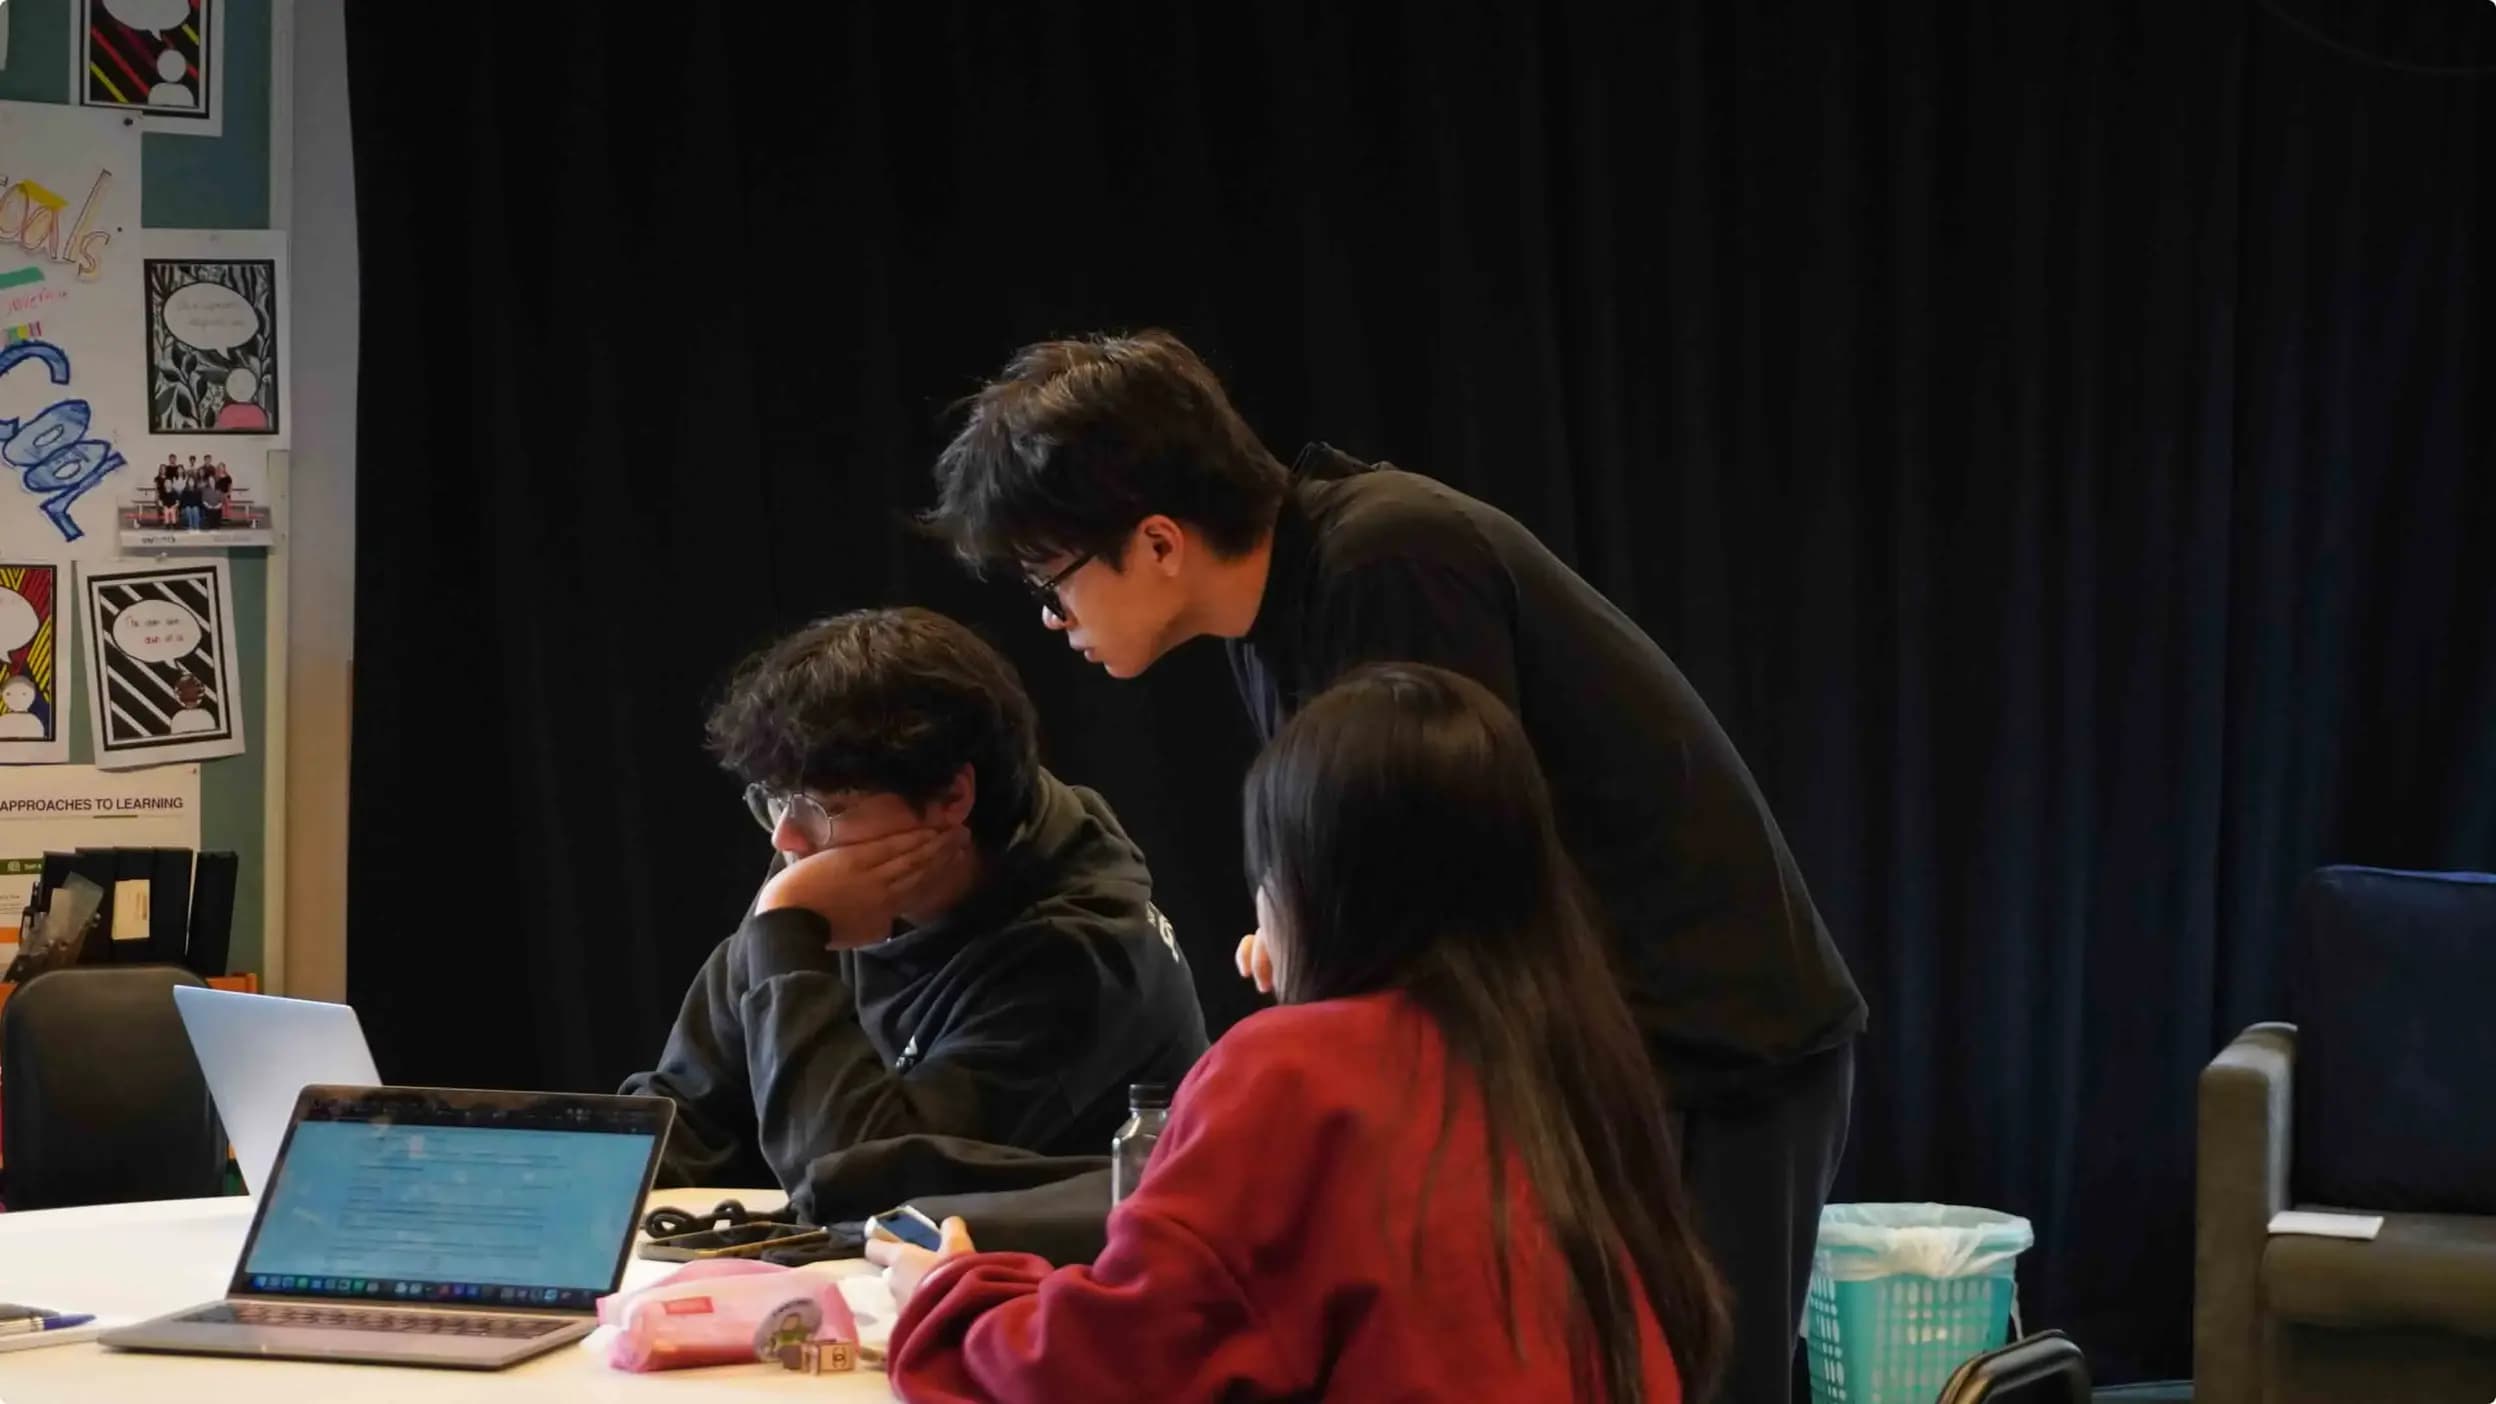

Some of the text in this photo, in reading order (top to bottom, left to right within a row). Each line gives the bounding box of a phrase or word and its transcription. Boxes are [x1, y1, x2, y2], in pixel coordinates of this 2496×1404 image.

[0, 168, 112, 280] oals
[0, 796, 184, 812] APPROACHES TO LEARNING
